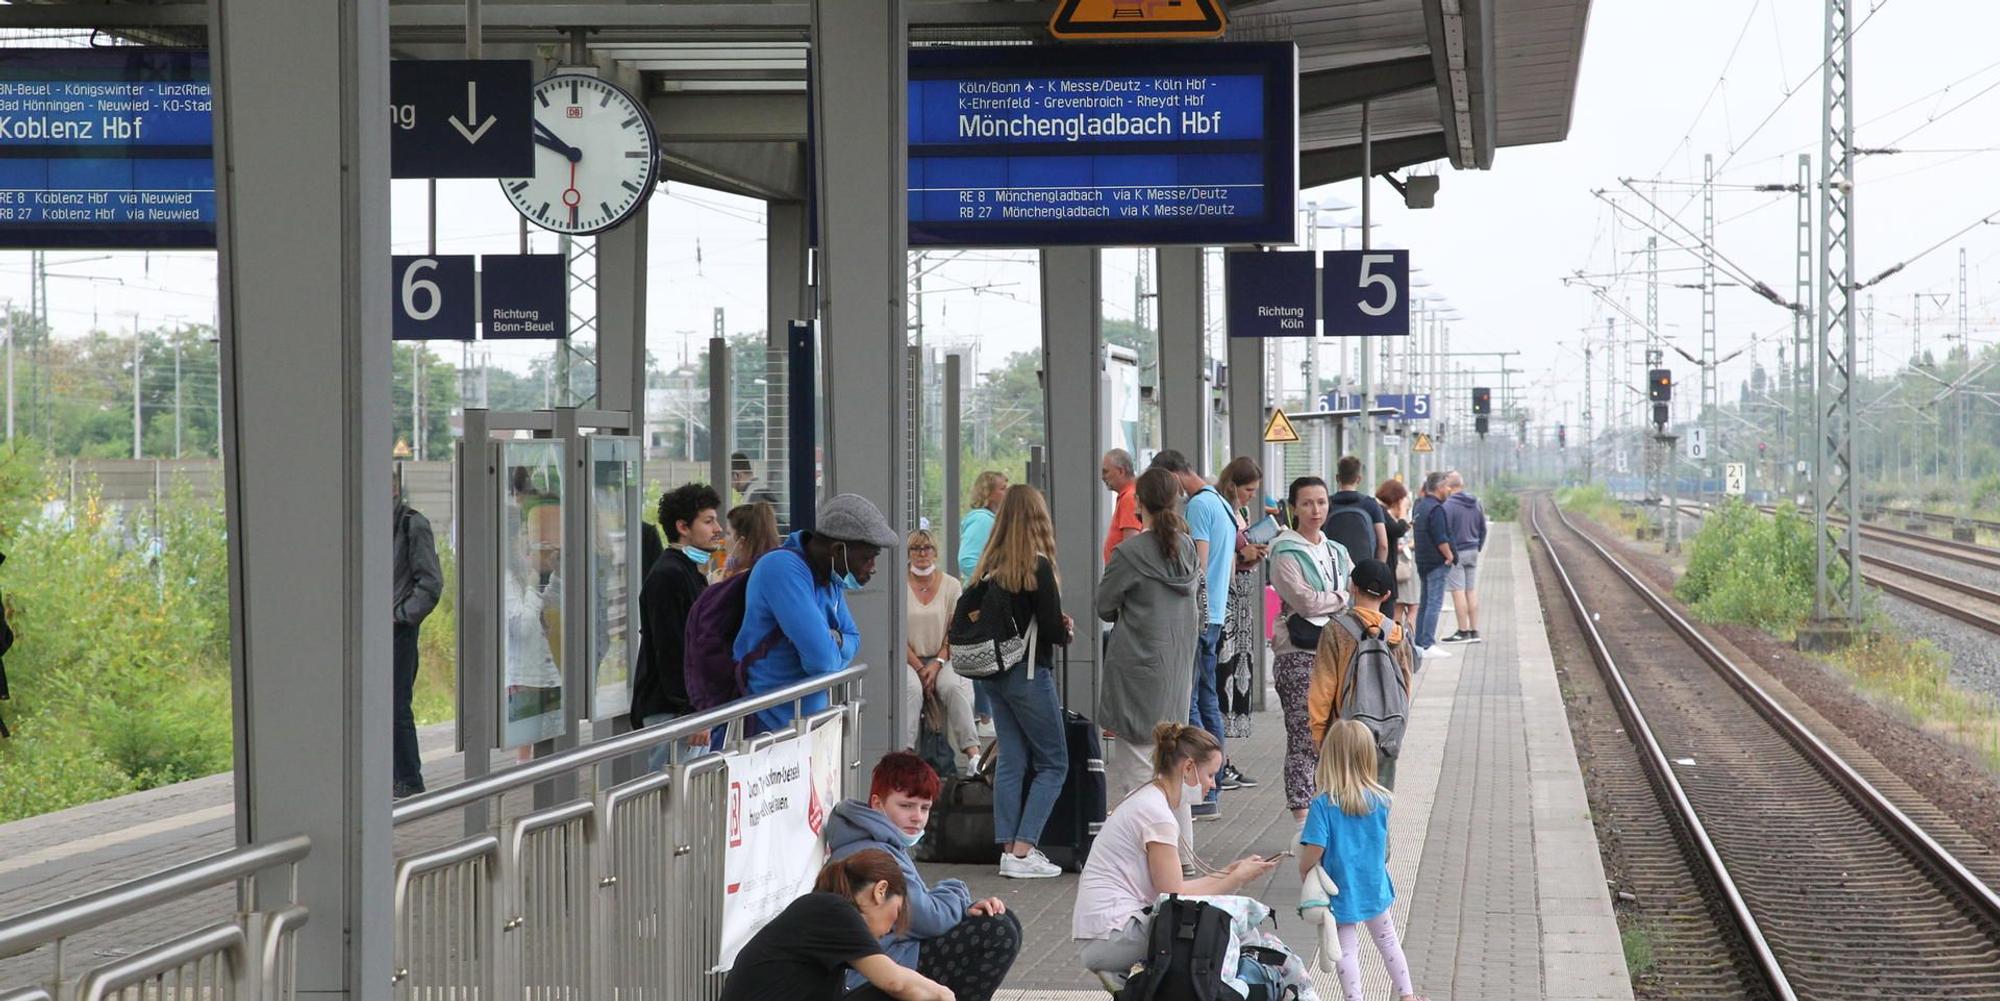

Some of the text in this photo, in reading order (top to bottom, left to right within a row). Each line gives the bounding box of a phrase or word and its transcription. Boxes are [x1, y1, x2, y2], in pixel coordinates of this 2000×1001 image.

[64, 83, 145, 98] Königswinter
[959, 81, 1021, 94] Köln/Bonn
[1048, 80, 1057, 93] K
[1060, 79, 1141, 93] Messe/Deutz
[1154, 78, 1183, 91] Köln
[1186, 78, 1207, 91] Hbf
[22, 99, 85, 114] Hönningen
[97, 99, 150, 112] Neuwied
[959, 96, 1031, 110] K-Ehrenfeld
[1043, 95, 1124, 109] Grevenbroich
[1137, 94, 1180, 109] Rheydt
[1184, 94, 1205, 107] Hbf
[102, 116, 143, 139] Hbf
[959, 111, 1221, 142] Mönchengladbach Hbf
[18, 192, 24, 204] 8
[35, 192, 83, 204] Koblenz
[88, 192, 108, 204] Hbf
[119, 192, 137, 204] via
[141, 192, 192, 204] Neuwied
[960, 187, 1228, 203] RE 8 Mönchengladbach via K Messe/Deutz
[17, 207, 33, 220] 27
[42, 207, 92, 220] Koblenz
[95, 208, 116, 220] Hbf
[125, 208, 145, 220] via
[148, 208, 200, 220] Neuwied
[959, 203, 1235, 220] RB 27 Mönchengladbach via K Messe/Deutz
[401, 258, 442, 321] 6
[1357, 254, 1397, 316] 5
[493, 308, 539, 321] Richtung
[1258, 306, 1304, 318] Richtung
[493, 321, 555, 332] Bonn-Beuel
[1280, 318, 1304, 329] Köln
[1318, 394, 1329, 412] 6
[1414, 395, 1428, 415] 5
[1692, 444, 1701, 456] 0
[1727, 465, 1744, 478] 21
[1732, 479, 1740, 490] 4
